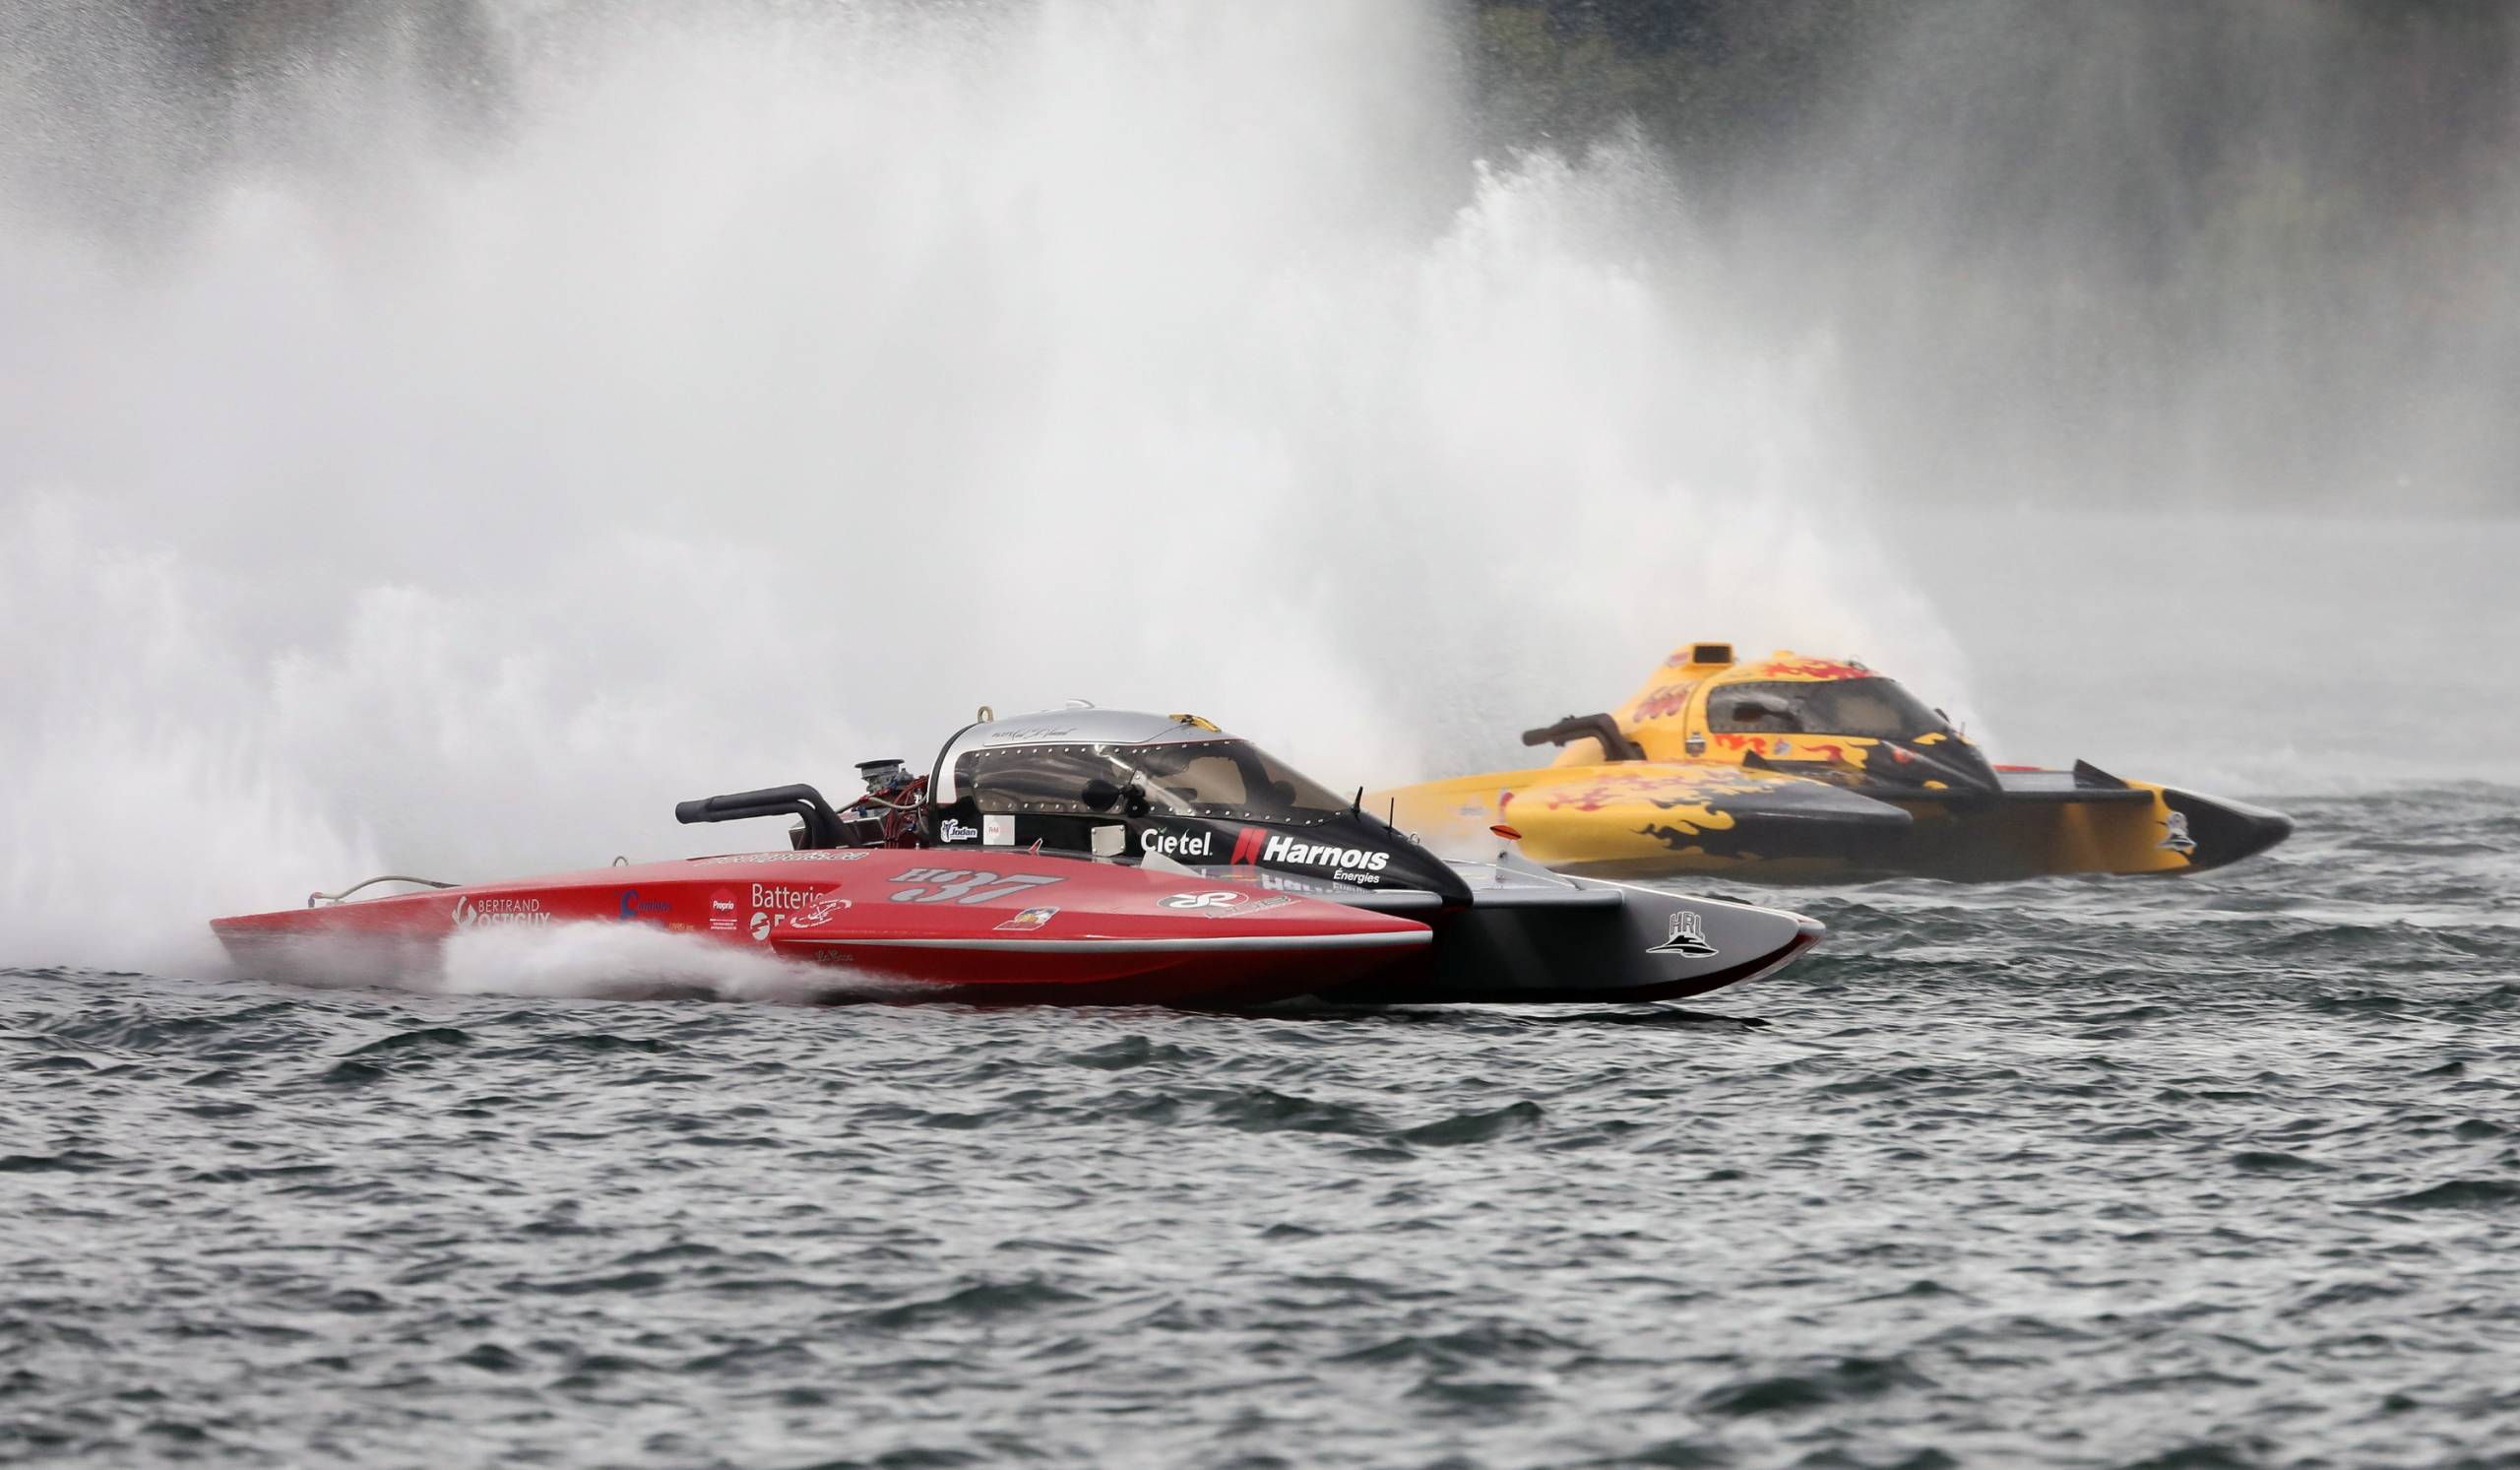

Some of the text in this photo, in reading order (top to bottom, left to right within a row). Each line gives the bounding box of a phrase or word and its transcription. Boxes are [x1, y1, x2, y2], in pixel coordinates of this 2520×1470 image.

[1263, 835, 1390, 870] Harnois
[1333, 867, 1380, 884] Énergies
[477, 893, 539, 913] BERTRAND
